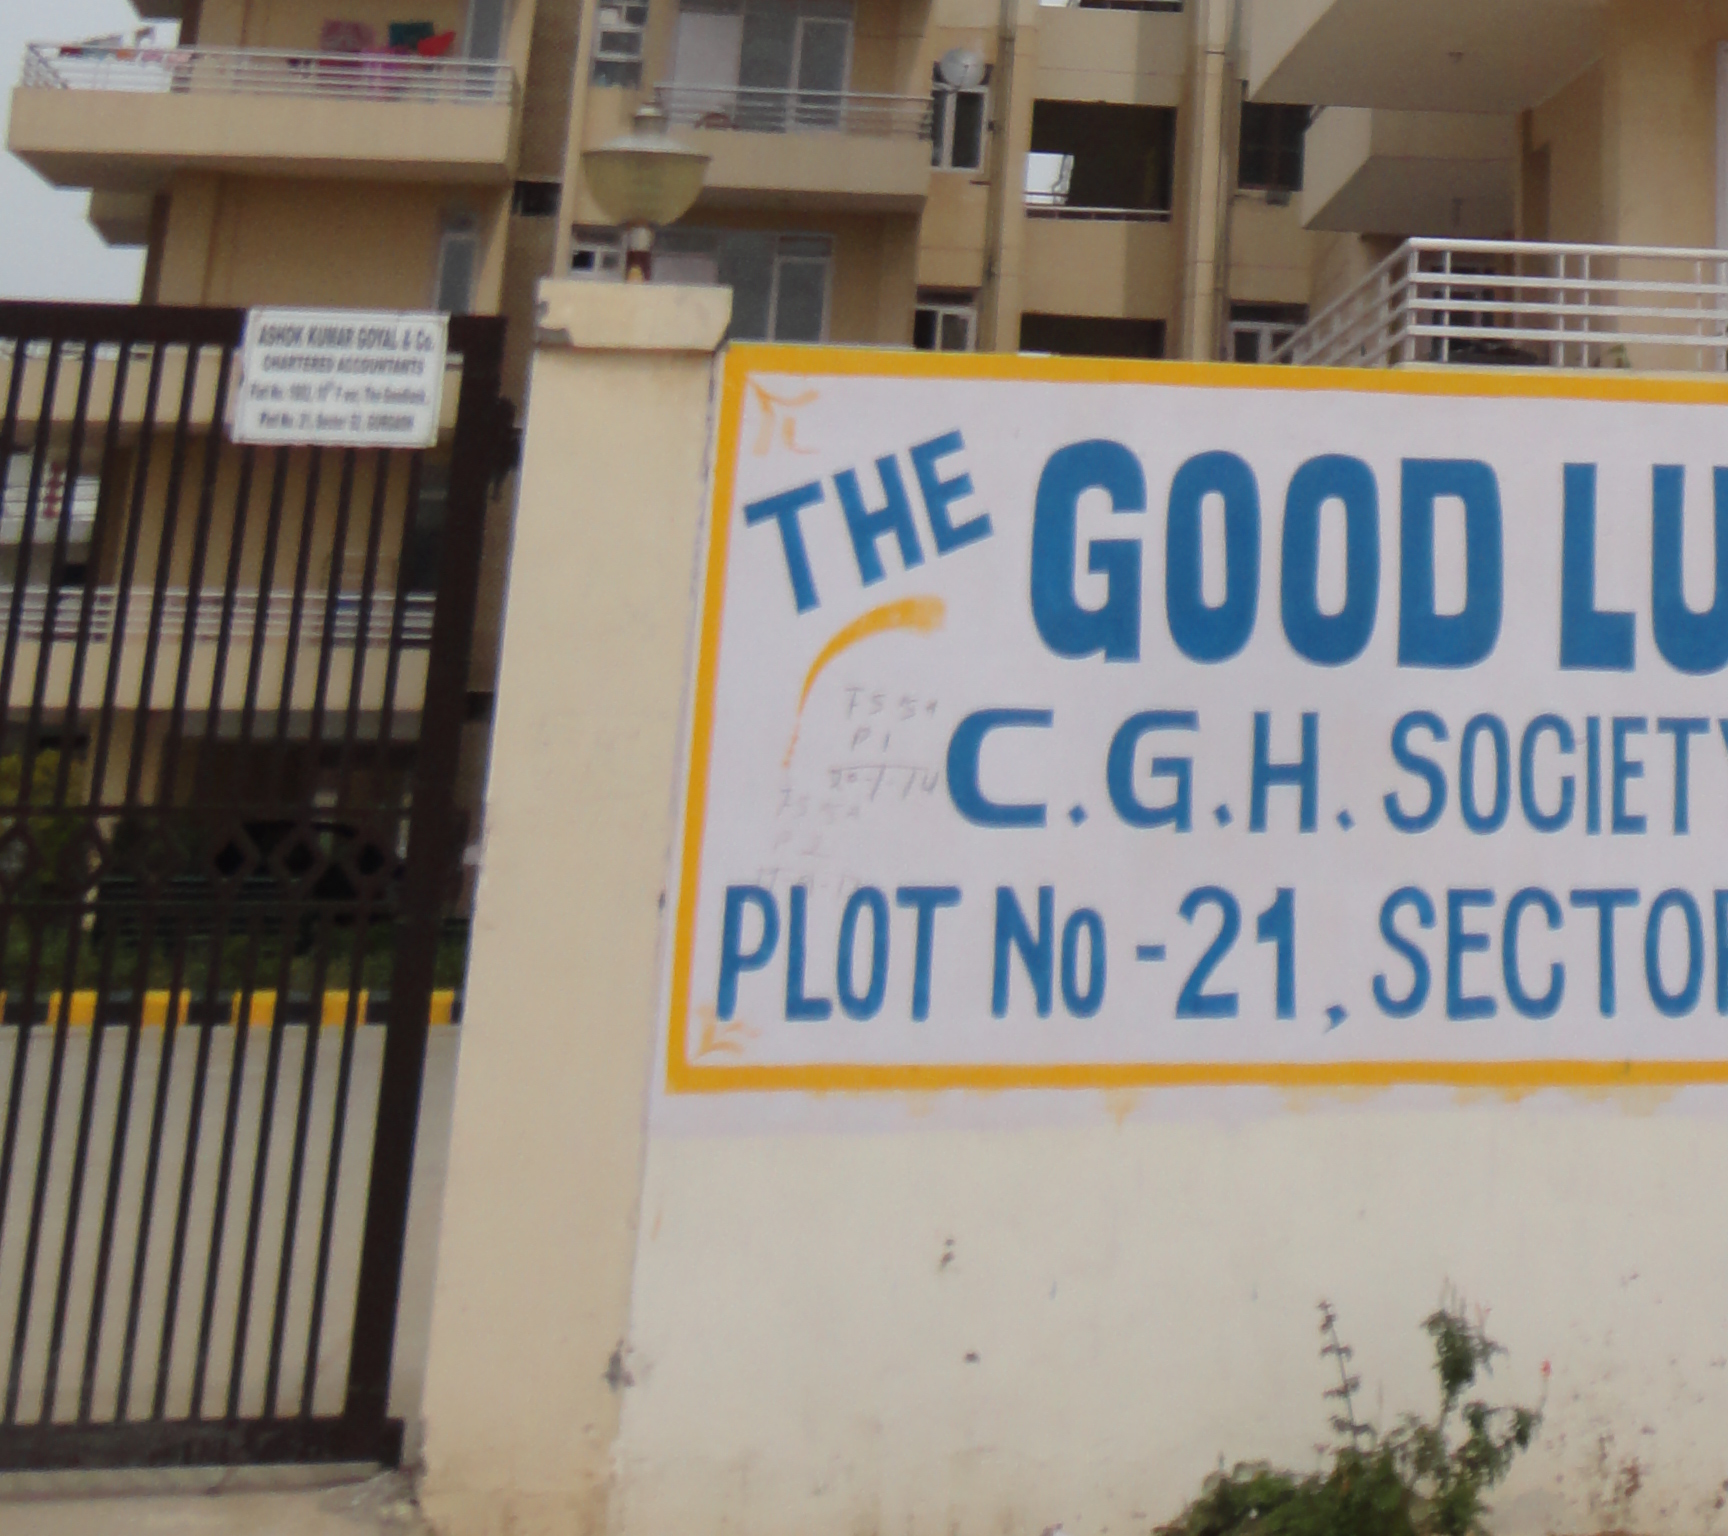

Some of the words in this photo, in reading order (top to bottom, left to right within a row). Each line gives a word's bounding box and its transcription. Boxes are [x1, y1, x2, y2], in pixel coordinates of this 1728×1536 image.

[263, 354, 335, 373] CHARTERED
[337, 356, 425, 376] ACCOUNTANTS
[307, 323, 354, 348] KUMAR
[357, 325, 398, 350] GOYAL
[746, 432, 993, 615] THE
[1031, 439, 1504, 669] GOOD
[717, 885, 962, 1023] PLOT
[993, 886, 1106, 1019] No
